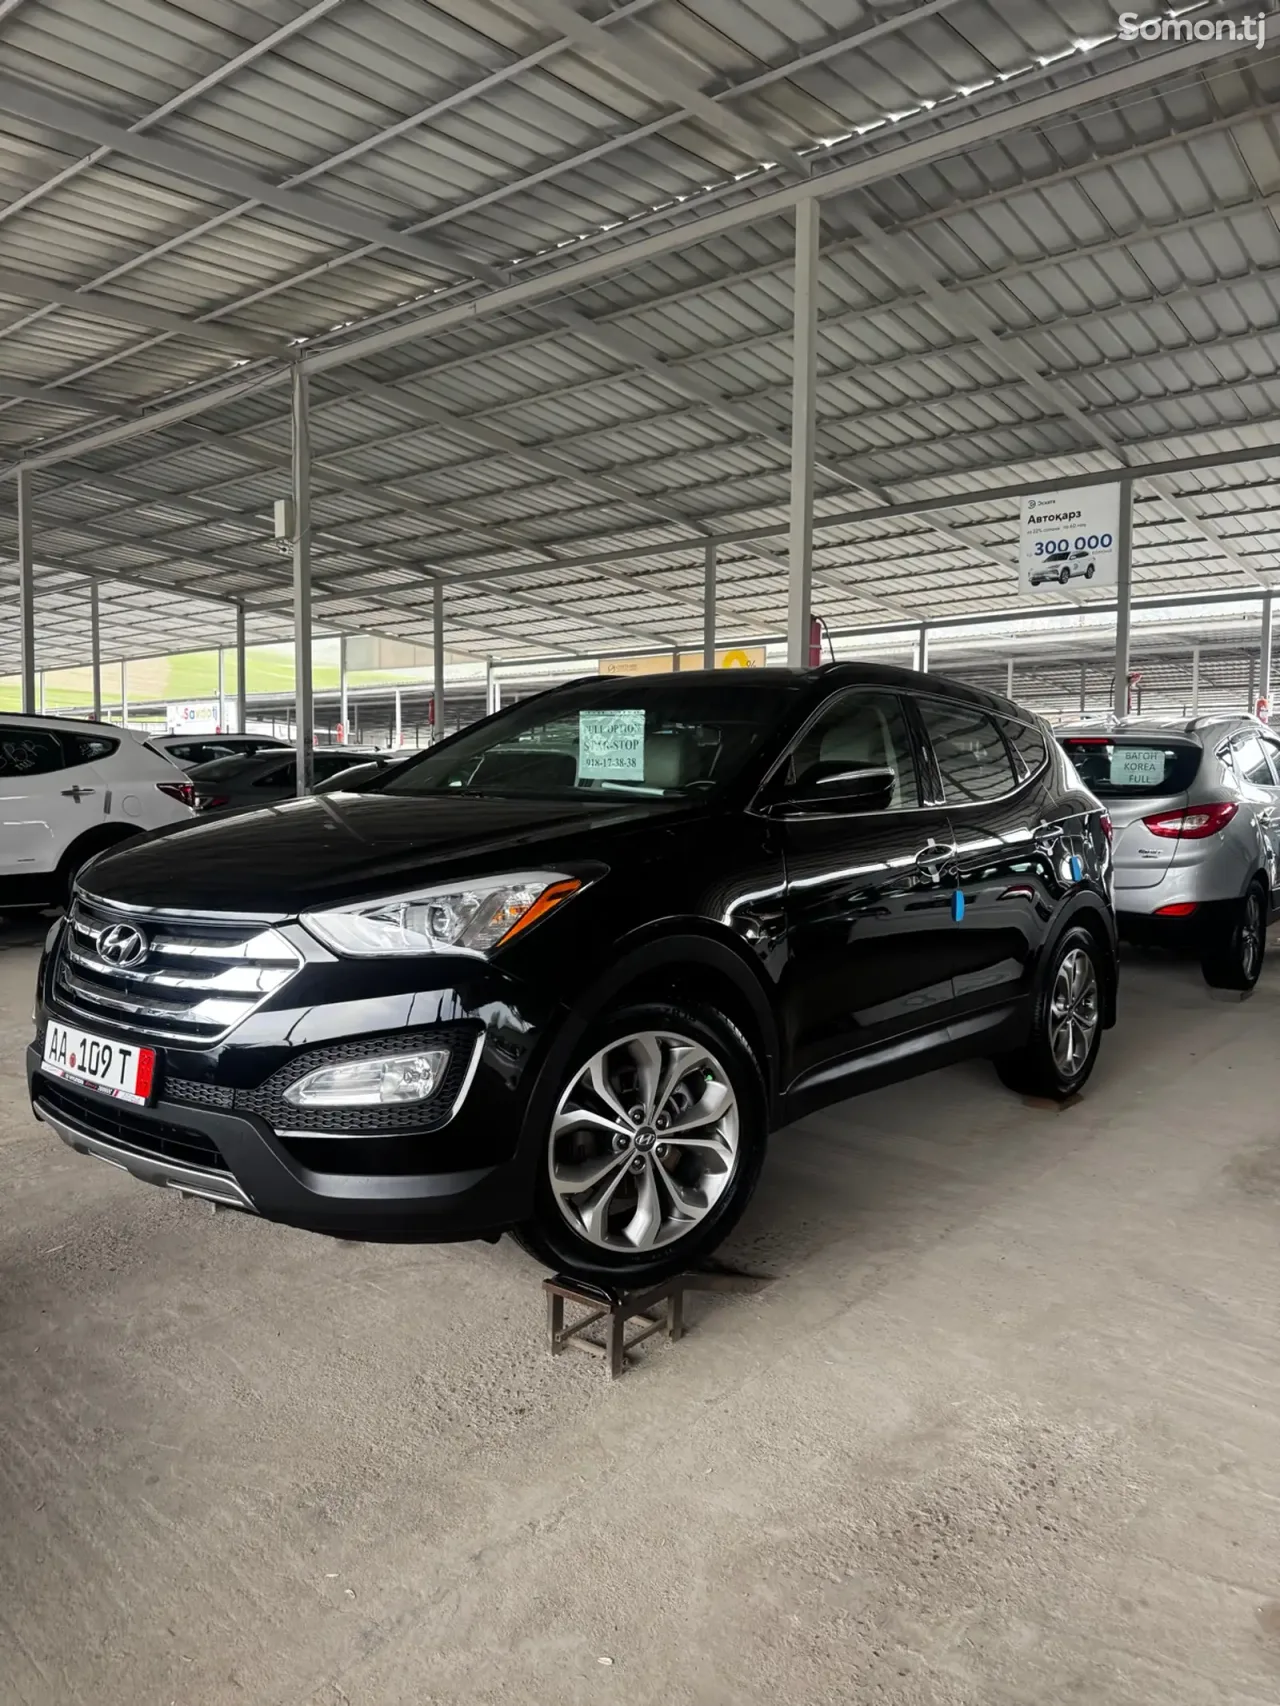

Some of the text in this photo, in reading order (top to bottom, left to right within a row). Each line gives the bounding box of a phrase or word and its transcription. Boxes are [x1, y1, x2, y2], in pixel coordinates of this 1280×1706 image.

[1034, 533, 1113, 556] 300 000
[586, 757, 637, 768] 918-17-38-38
[1123, 762, 1156, 771] KOREA
[1128, 774, 1151, 784] FULL
[48, 1027, 68, 1066] AA
[77, 1037, 113, 1079] 109
[118, 1047, 132, 1085] T
